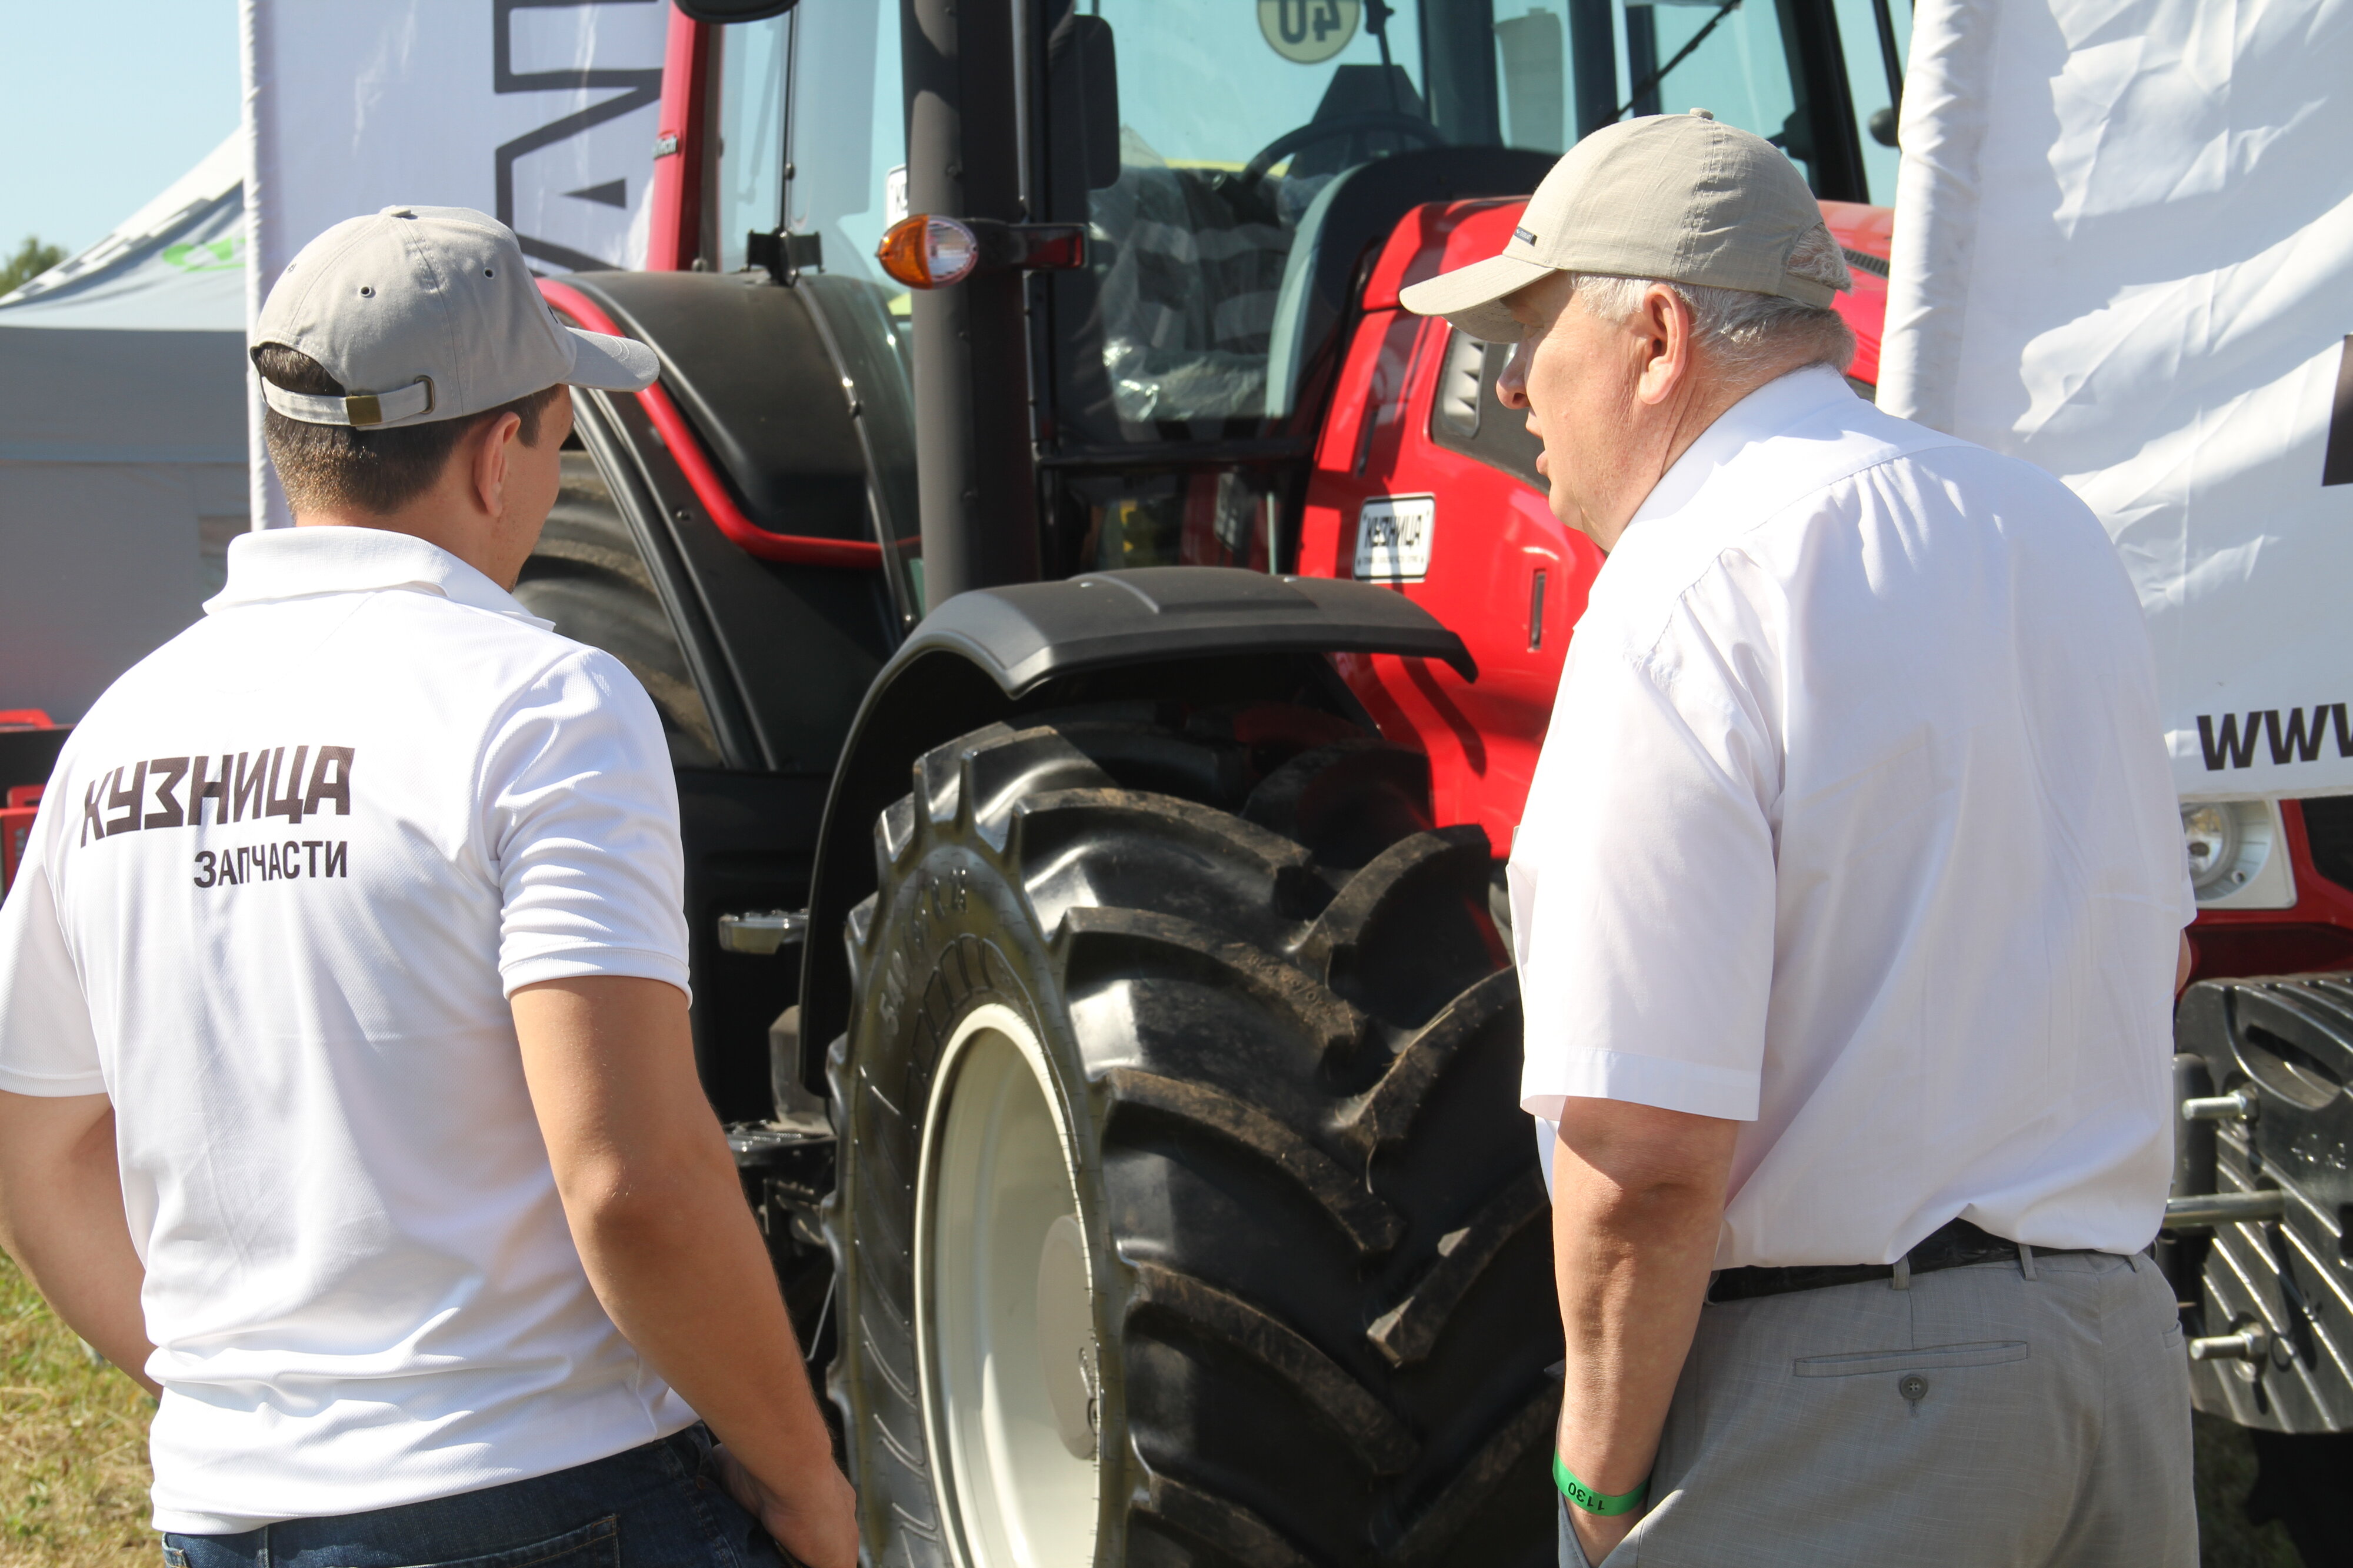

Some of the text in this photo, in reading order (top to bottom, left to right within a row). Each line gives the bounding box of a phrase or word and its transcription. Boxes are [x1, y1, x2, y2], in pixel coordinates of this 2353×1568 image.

[80, 745, 355, 849] КУЗНИЦА
[194, 840, 348, 888] ЗАПЧАСТИ
[1568, 1482, 1605, 1511] 1130
